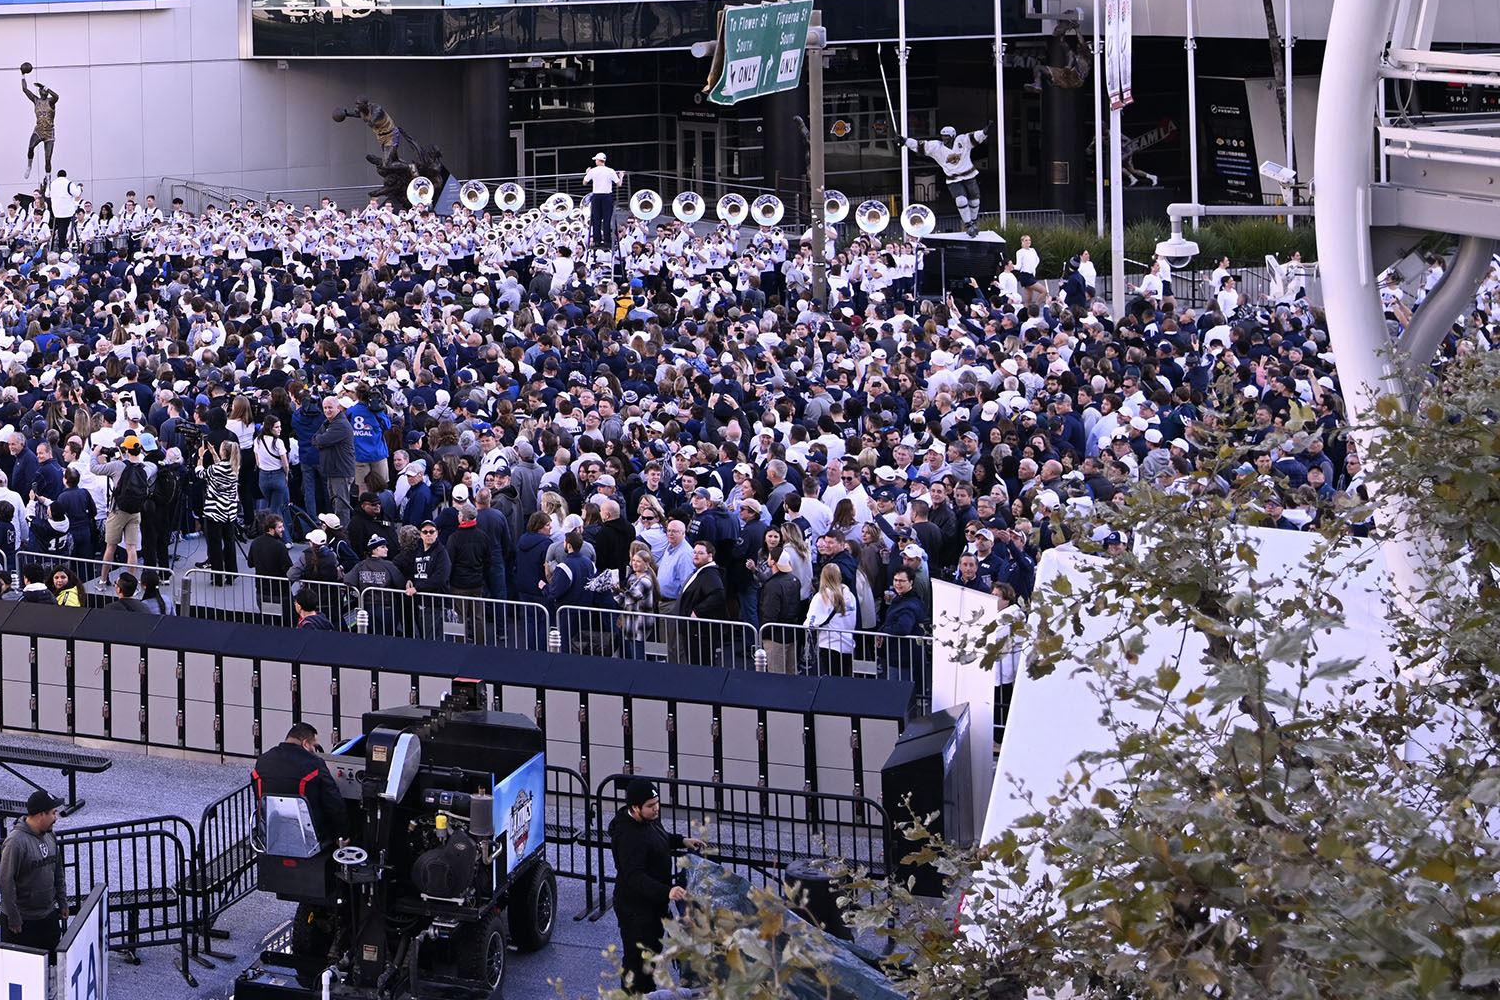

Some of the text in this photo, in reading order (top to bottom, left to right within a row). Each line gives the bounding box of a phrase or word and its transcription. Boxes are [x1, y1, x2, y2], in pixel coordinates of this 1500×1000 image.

[730, 13, 768, 33] To Flower St
[775, 8, 808, 29] Figueroa St
[738, 64, 757, 83] ONLY
[780, 56, 798, 75] ONLY
[353, 415, 365, 430] 8
